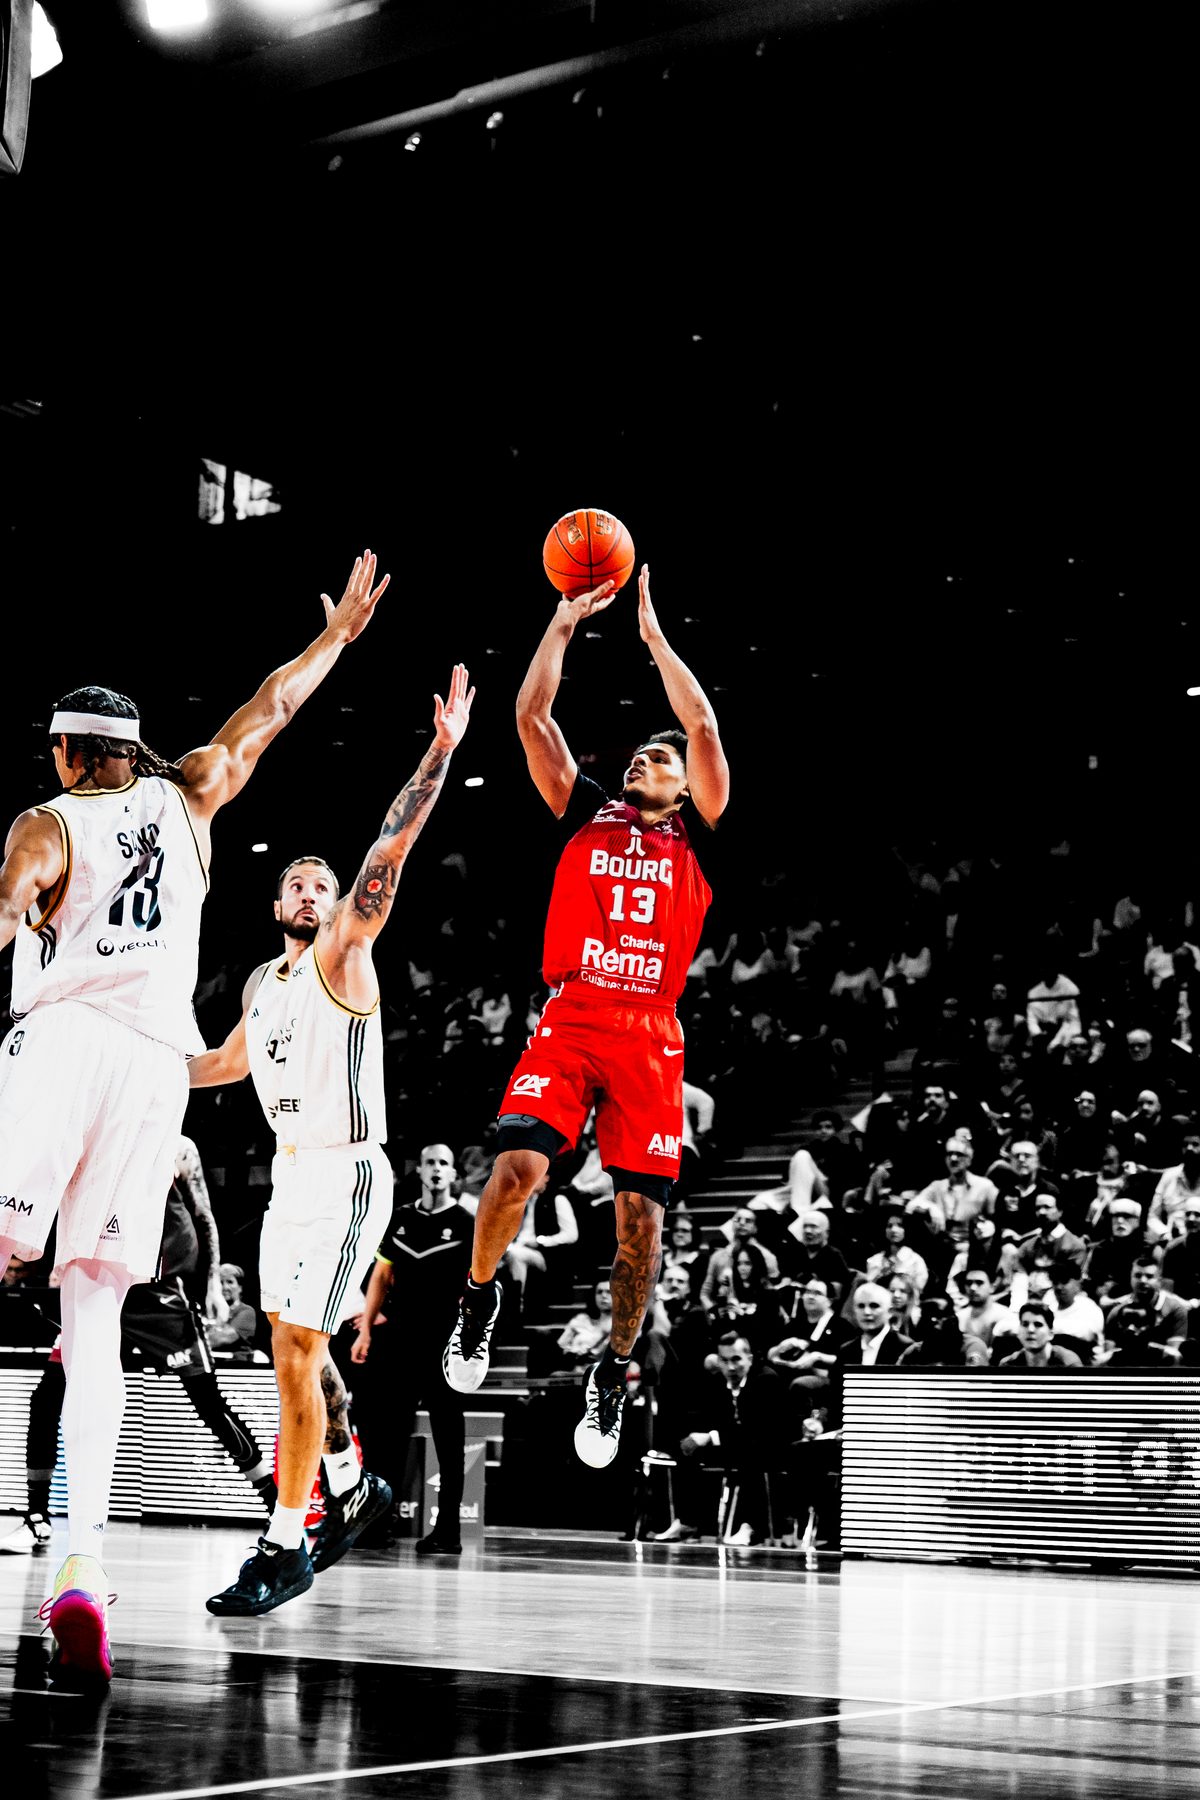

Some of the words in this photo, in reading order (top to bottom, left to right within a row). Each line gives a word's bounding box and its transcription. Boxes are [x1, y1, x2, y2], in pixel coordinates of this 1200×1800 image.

[589, 849, 673, 889] BOURG
[609, 884, 656, 924] 13
[118, 939, 167, 954] VEOLI
[581, 937, 663, 980] Réma
[620, 934, 665, 953] Charles
